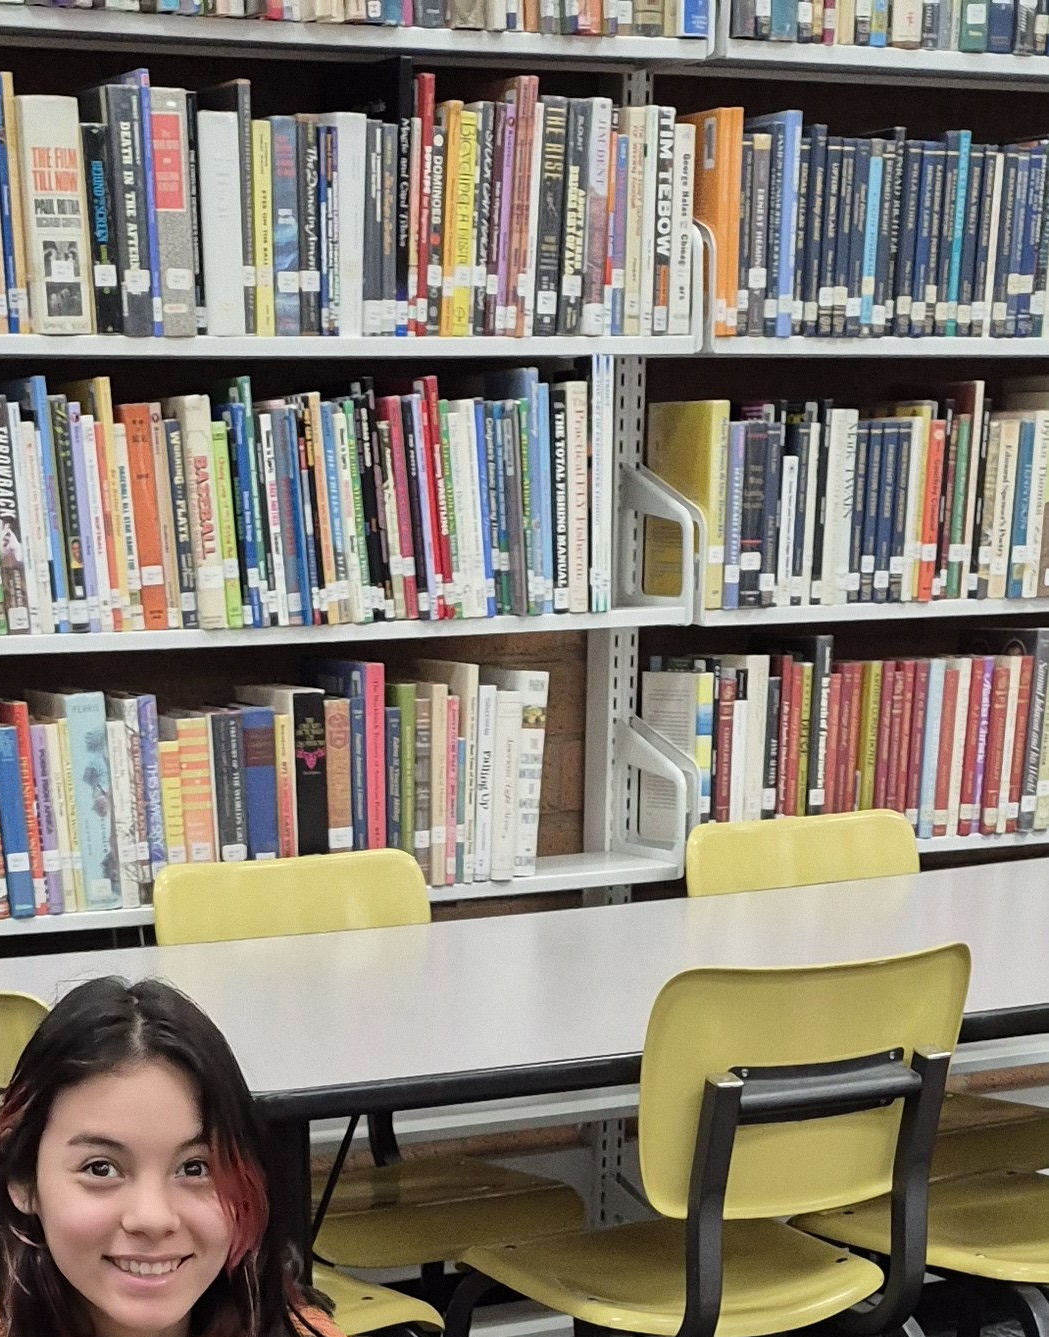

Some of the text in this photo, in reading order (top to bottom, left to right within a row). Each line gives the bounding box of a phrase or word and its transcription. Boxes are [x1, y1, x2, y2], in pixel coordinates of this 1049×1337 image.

[30, 146, 78, 170] THE FILM
[120, 122, 137, 217] DEATH IN THE
[544, 107, 565, 181] THE RISE
[596, 118, 611, 186] JIM DENT
[91, 160, 104, 197] BEHIND
[305, 145, 318, 211] The Dance
[398, 118, 410, 247] Magic and Card Tricks
[432, 155, 444, 225] DOMINOES
[656, 118, 675, 257] TIM TEBOW
[680, 153, 691, 217] George Halas
[574, 409, 587, 508] Practical FLY
[1002, 445, 1013, 483] Edmund
[175, 499, 189, 543] PLATE
[193, 455, 216, 560] BASEBALL
[555, 411, 568, 587] THE TOTAL FISHING MANUAL
[38, 749, 50, 776] POEMS
[146, 764, 159, 789] THIS
[477, 750, 492, 810] Falling Up
[148, 790, 160, 821] SAME
